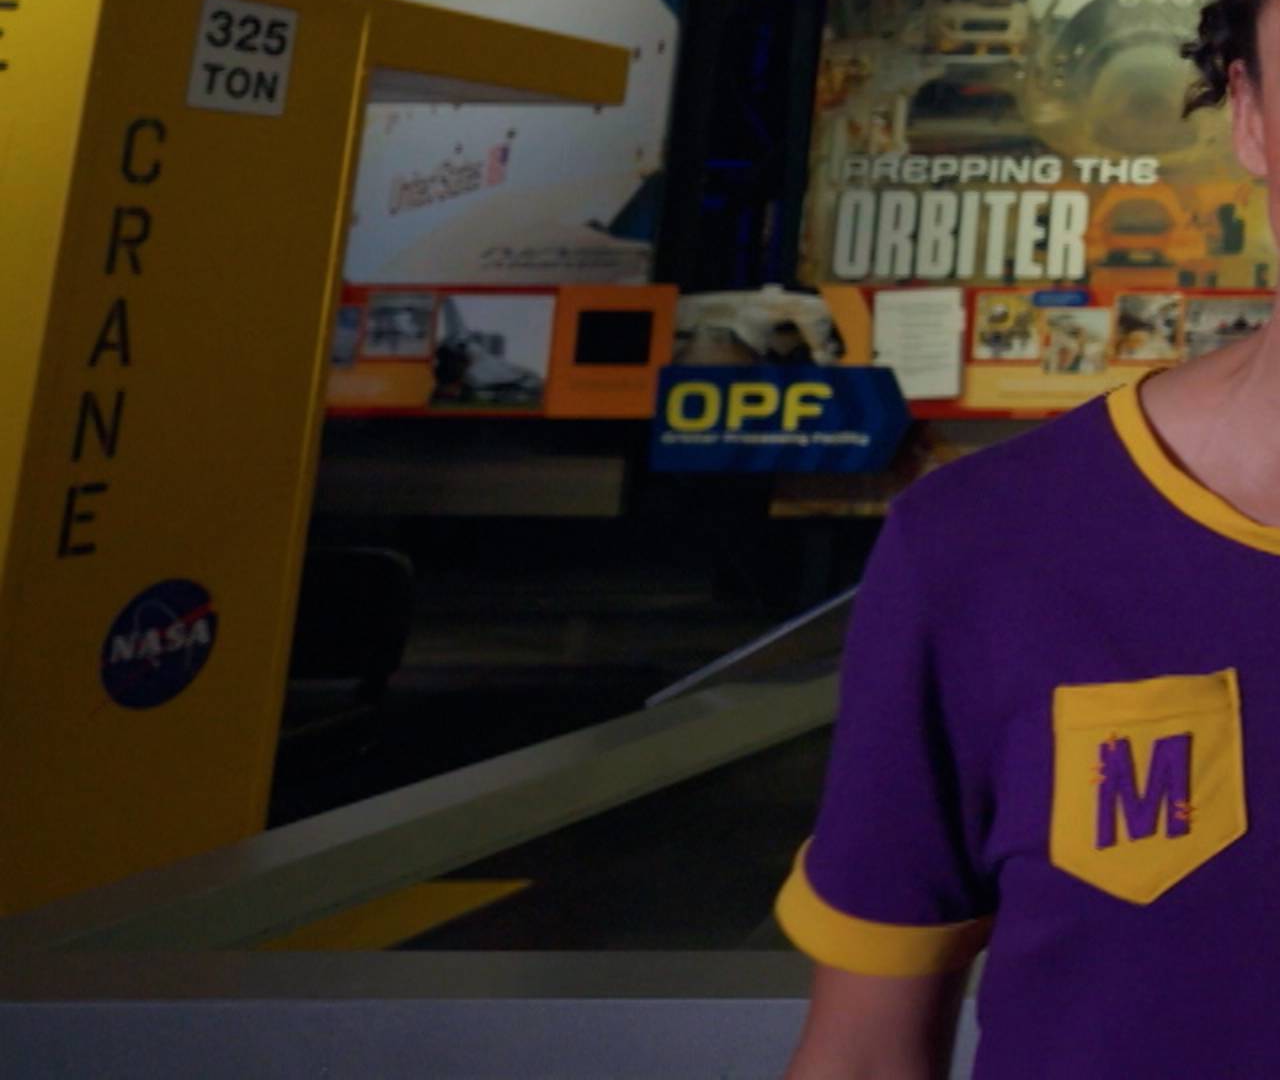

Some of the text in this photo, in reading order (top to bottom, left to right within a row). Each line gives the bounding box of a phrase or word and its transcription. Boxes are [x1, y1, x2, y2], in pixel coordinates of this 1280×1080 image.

[204, 10, 288, 57] 325
[201, 62, 280, 103] TON
[841, 153, 1161, 186] PREPPING THE
[831, 189, 1091, 281] ORBITER
[57, 118, 166, 559] CRANE
[664, 380, 834, 433] OPF
[110, 616, 214, 664] NASA
[1094, 731, 1194, 851] M
